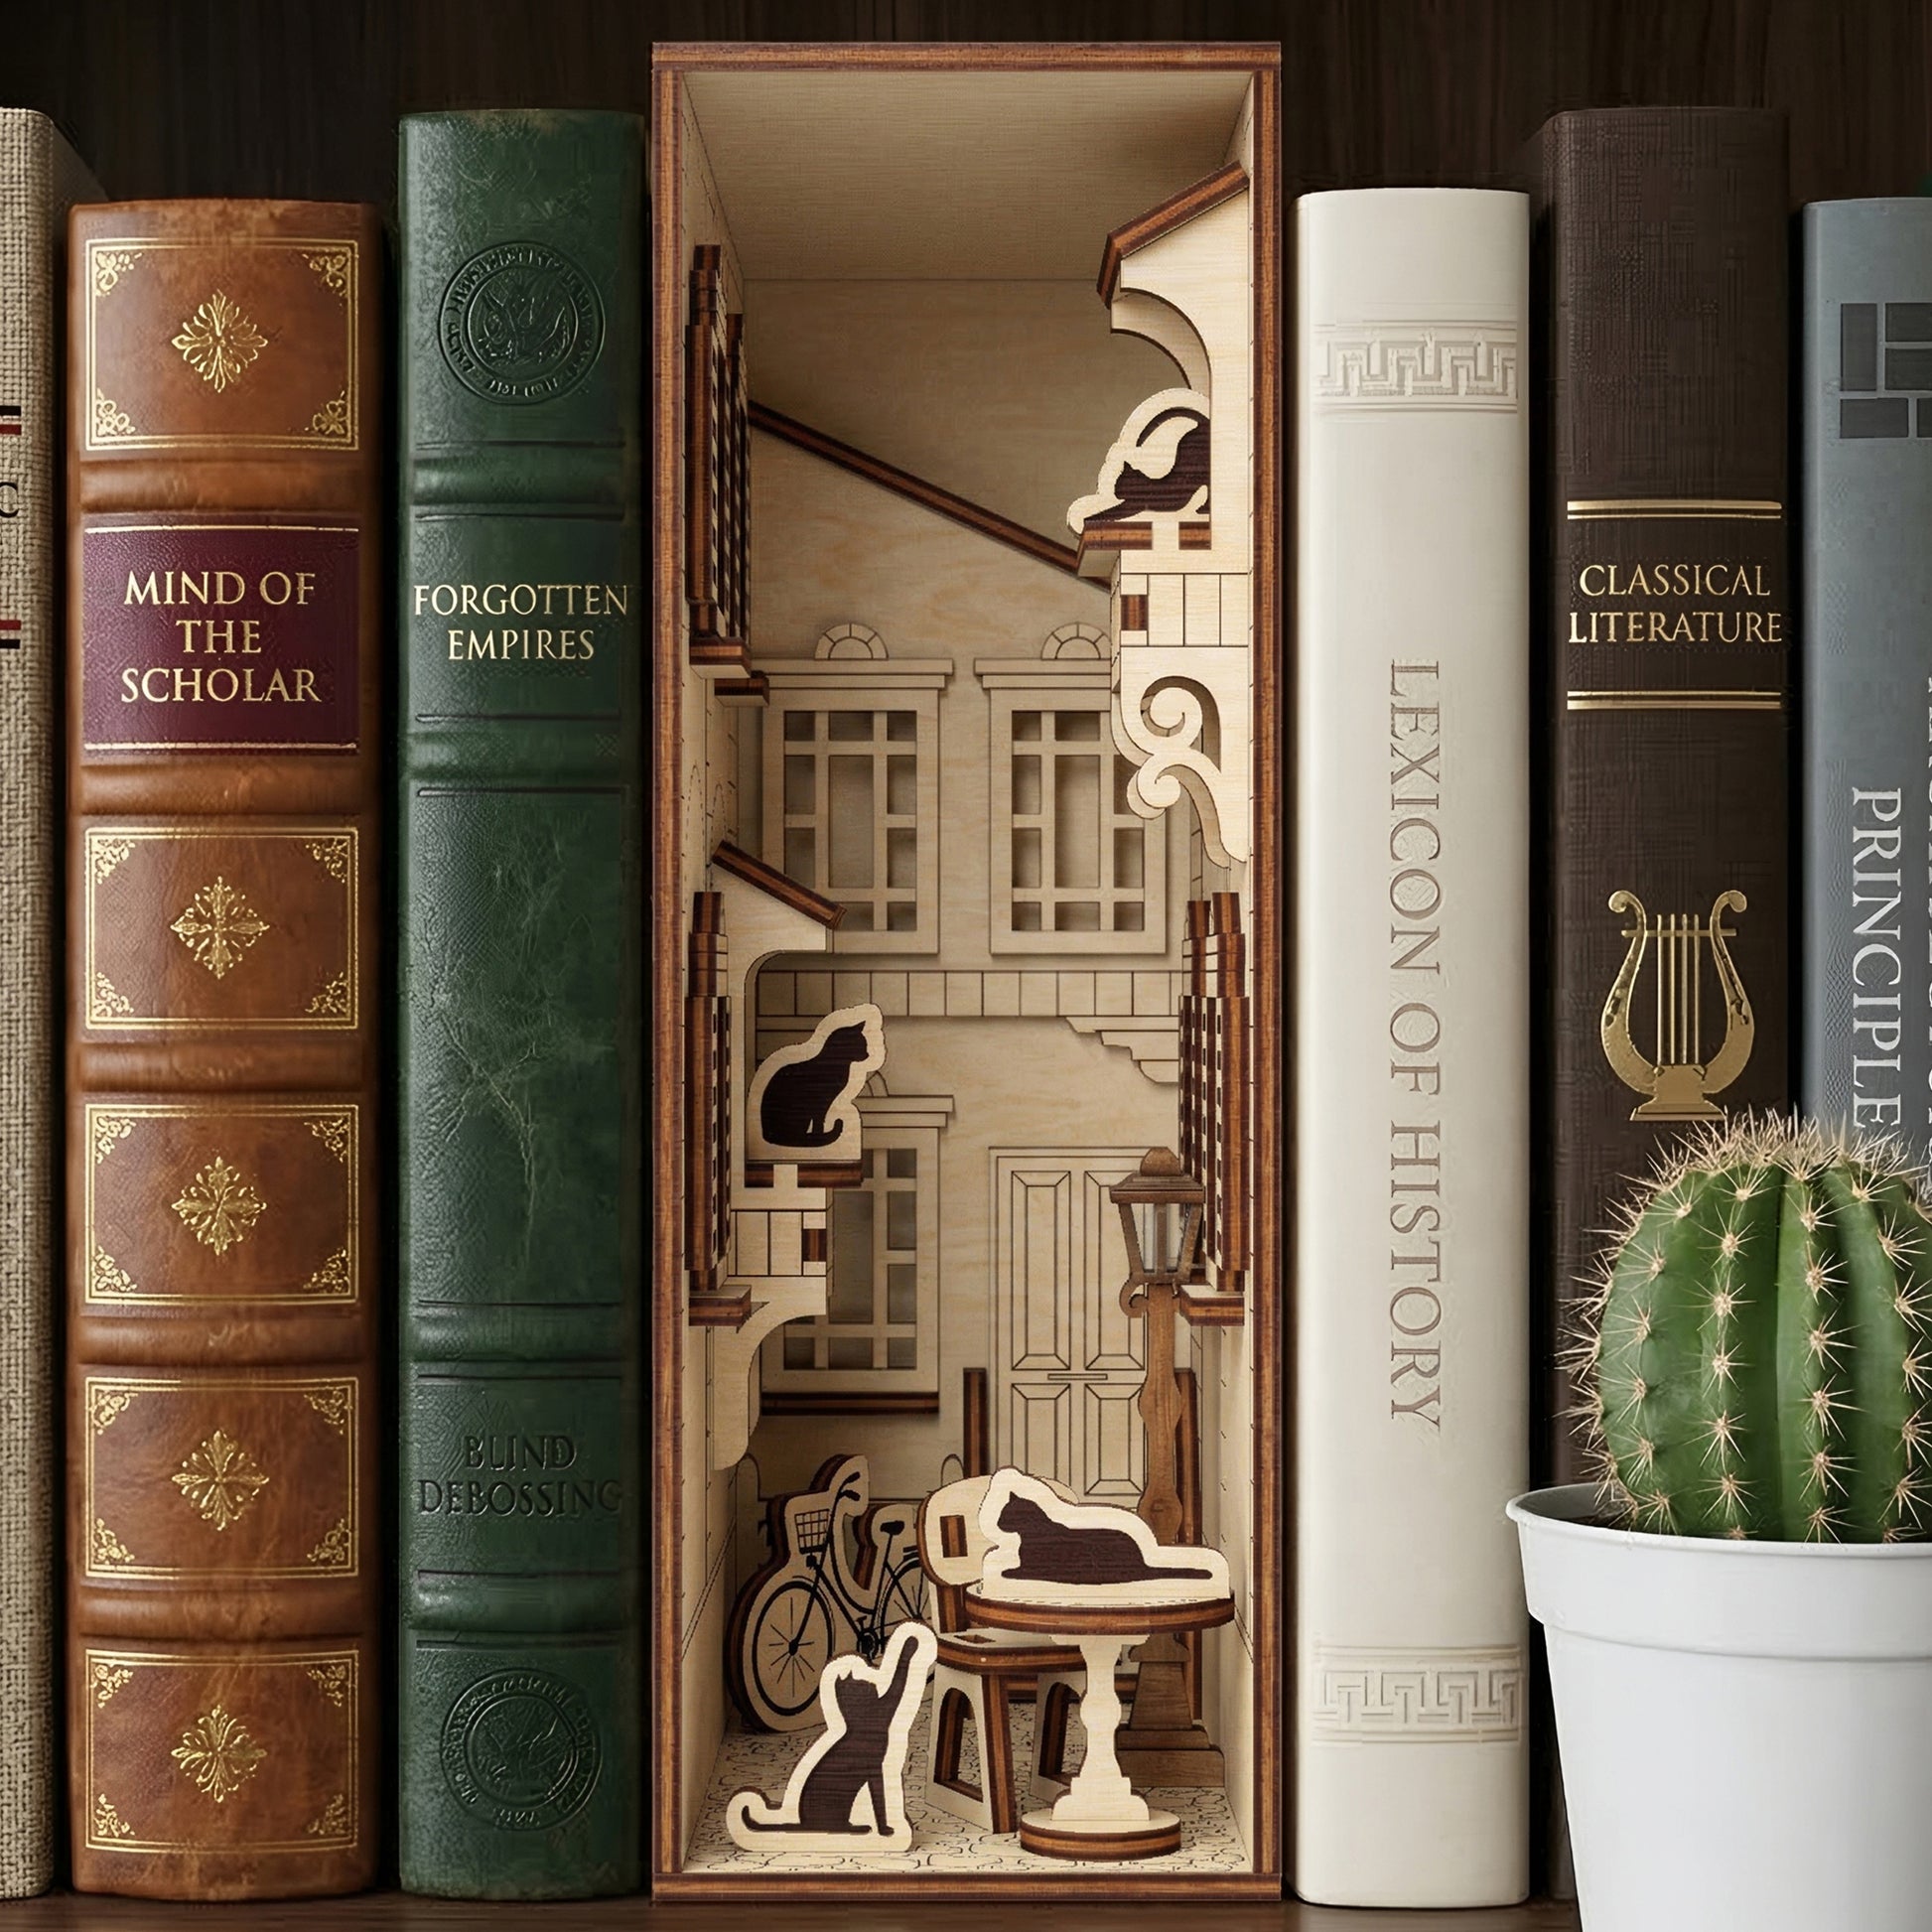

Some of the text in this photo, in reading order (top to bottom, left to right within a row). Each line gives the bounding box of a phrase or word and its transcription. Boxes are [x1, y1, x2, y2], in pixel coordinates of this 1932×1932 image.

[124, 570, 317, 606] MIND OF
[1579, 563, 1771, 597] CLASSICAL
[413, 583, 629, 617] FORGOTTEN
[175, 619, 262, 654] THE
[447, 628, 595, 660] EMPIRES
[1568, 611, 1783, 644] LITERATURE
[120, 666, 323, 703] SCHOLAR
[1389, 658, 1443, 1428] LEXICON OF HISTORY
[417, 1478, 622, 1518] DEBOSSING
